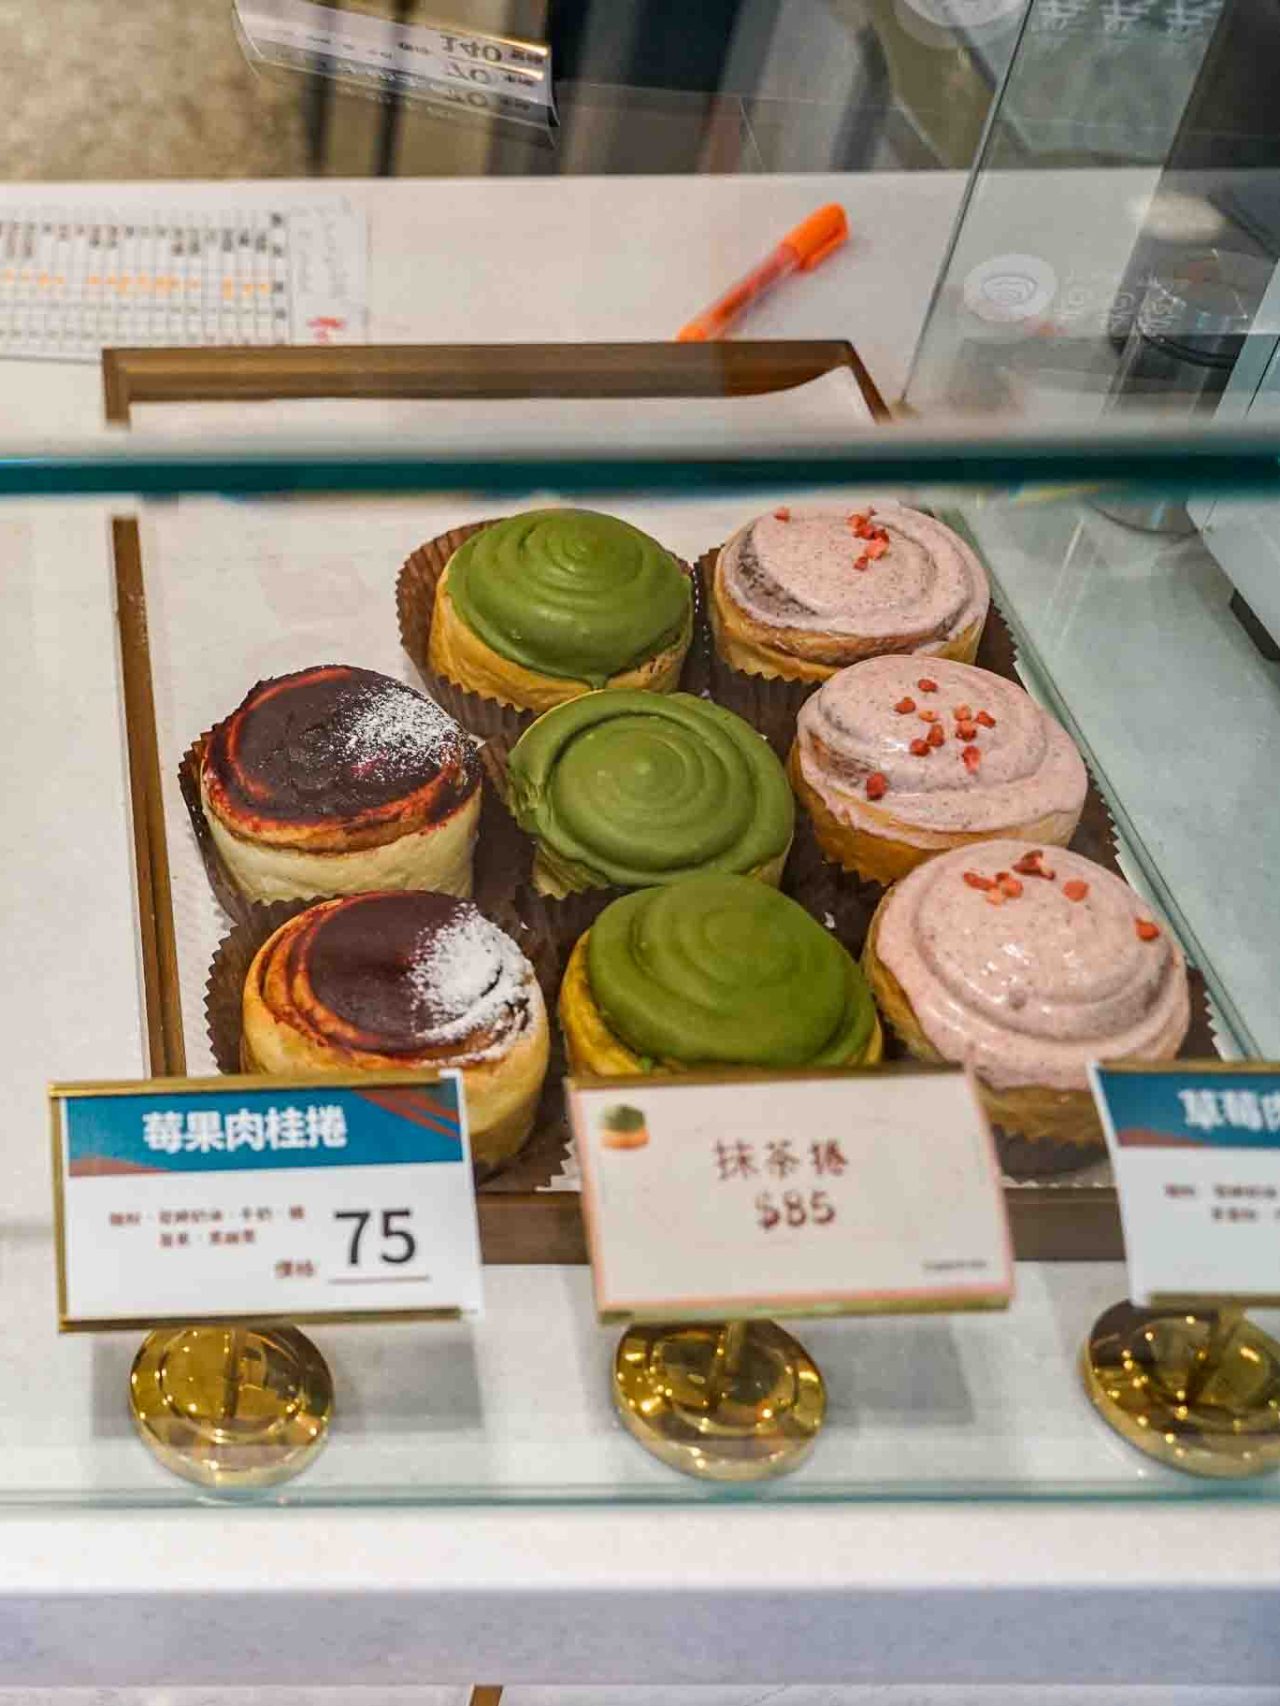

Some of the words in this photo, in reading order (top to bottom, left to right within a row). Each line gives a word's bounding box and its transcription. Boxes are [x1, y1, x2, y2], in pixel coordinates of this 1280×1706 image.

[142, 1106, 348, 1152] 莓果肉桂捲
[712, 1138, 849, 1181] 抹茶捲
[754, 1191, 836, 1232] $85
[335, 1207, 417, 1267] 75
